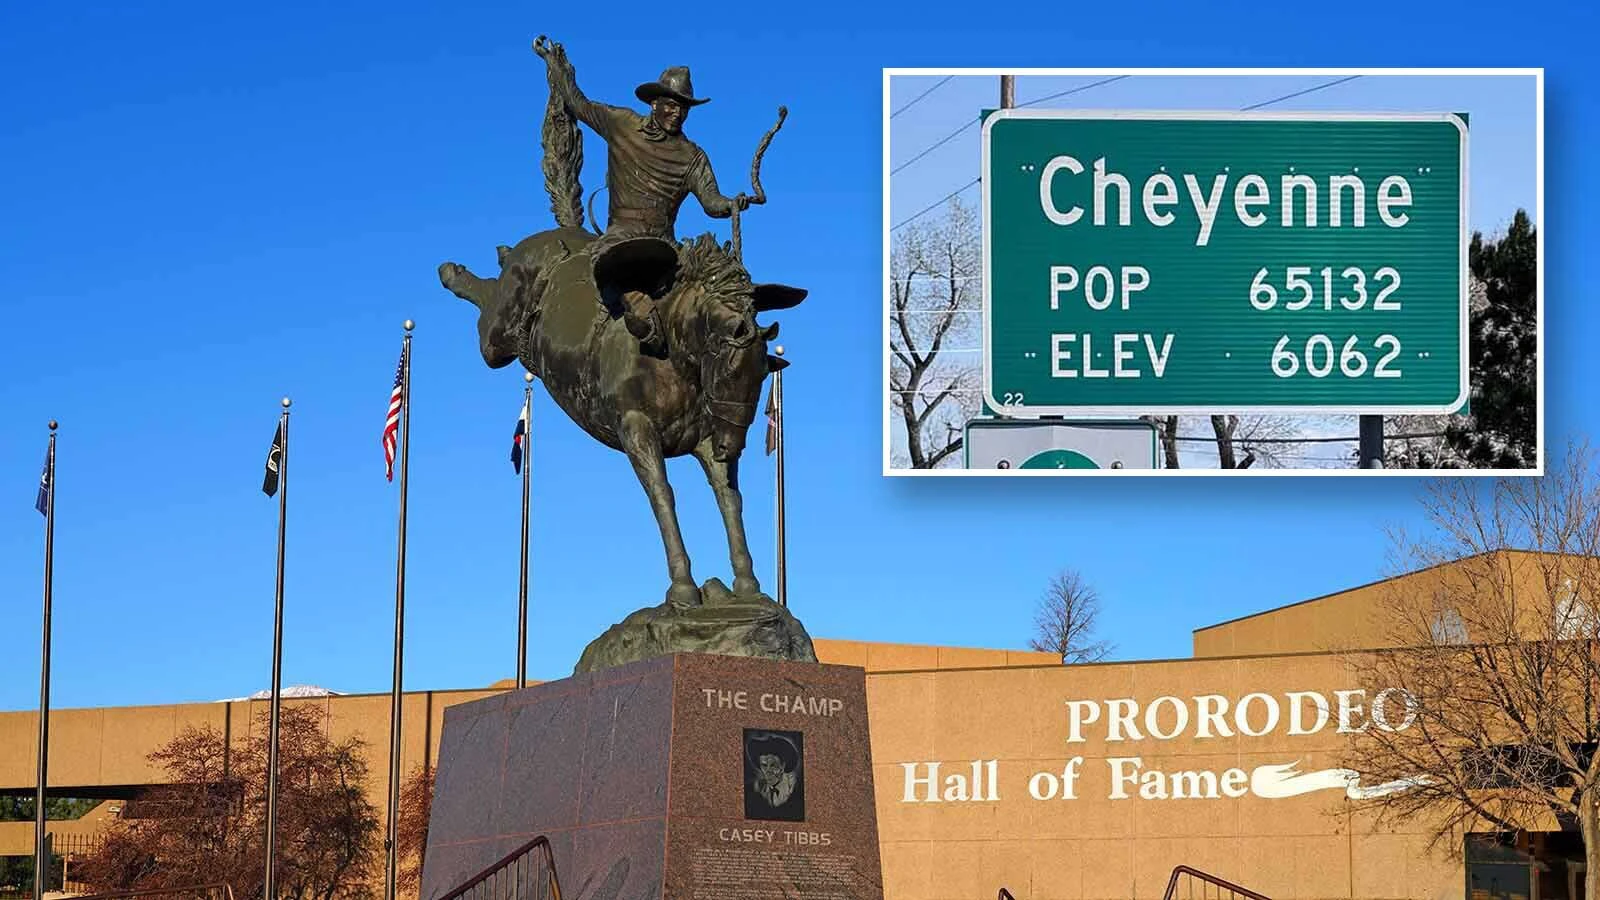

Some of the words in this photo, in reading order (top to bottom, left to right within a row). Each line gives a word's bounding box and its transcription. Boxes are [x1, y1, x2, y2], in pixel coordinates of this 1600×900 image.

[1039, 155, 1413, 246] Cheyenne
[1050, 266, 1151, 310] POP
[1249, 266, 1402, 311] 65132
[1051, 333, 1175, 378] ELEV
[1271, 334, 1402, 378] 6062
[1003, 392, 1024, 407] 22
[702, 688, 747, 710] THE
[760, 693, 843, 717] CHAMP
[1066, 687, 1418, 743] PRORODEO
[901, 759, 998, 802] Hall
[1029, 757, 1083, 801] of
[1107, 756, 1249, 801] Fame
[719, 828, 775, 843] CASEY
[784, 831, 831, 846] TIBBS
